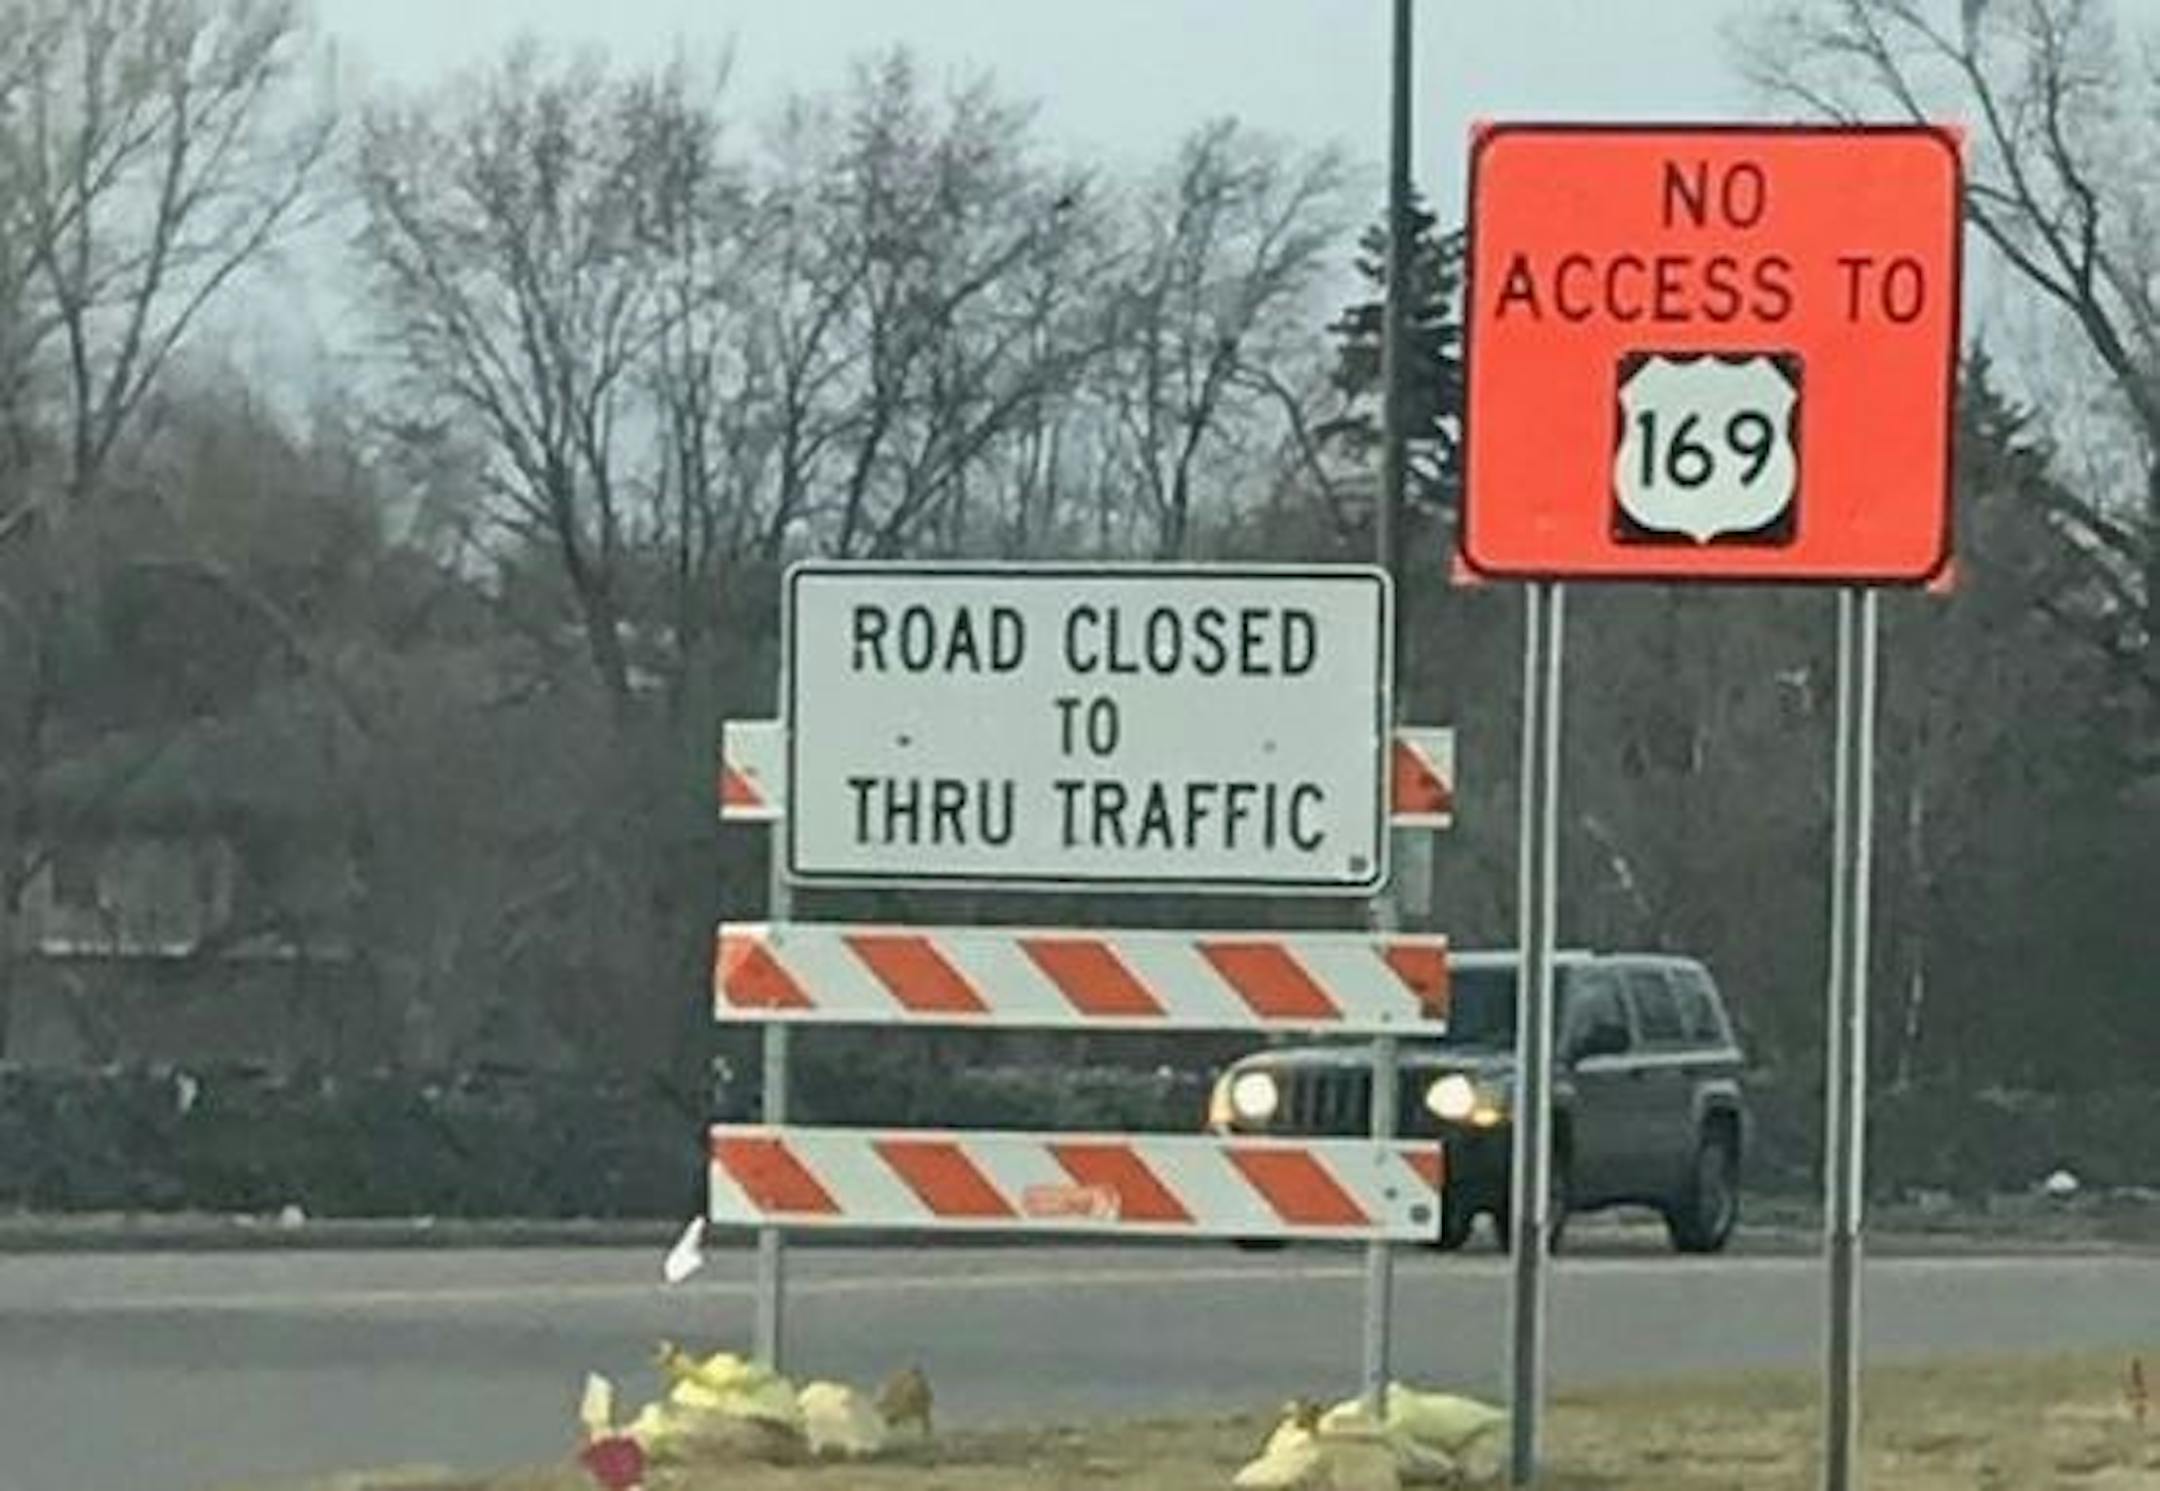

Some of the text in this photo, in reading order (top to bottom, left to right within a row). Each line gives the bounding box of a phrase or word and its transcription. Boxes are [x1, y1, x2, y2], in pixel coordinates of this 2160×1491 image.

[1661, 159, 1767, 231] NO
[1492, 251, 1927, 326] ACCESS TO
[1636, 408, 1776, 490] 169
[851, 603, 1318, 678] ROAD CLOSED
[1053, 695, 1121, 758] TO
[846, 776, 1326, 854] THRU TRAFFIC
